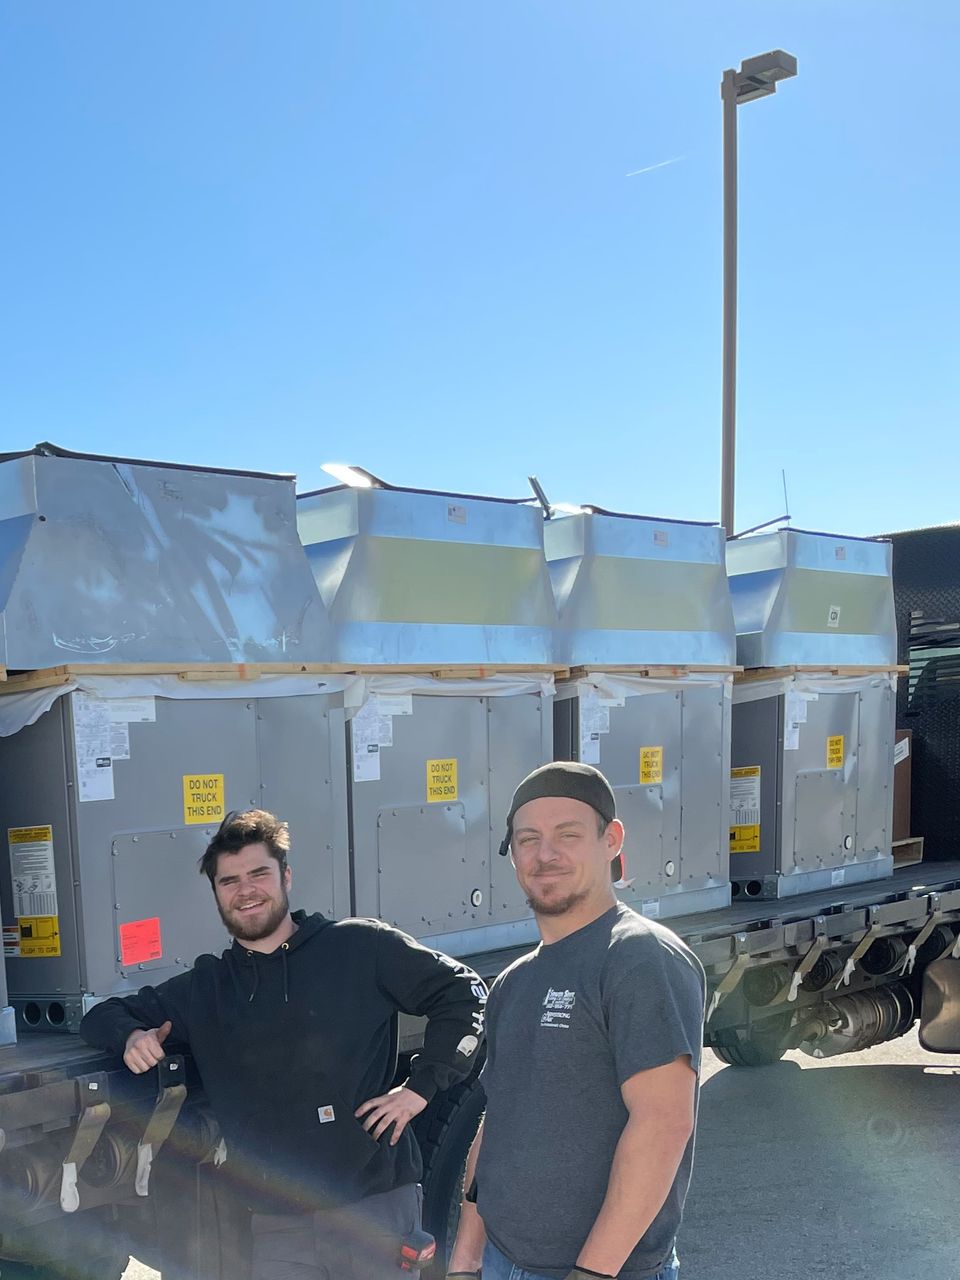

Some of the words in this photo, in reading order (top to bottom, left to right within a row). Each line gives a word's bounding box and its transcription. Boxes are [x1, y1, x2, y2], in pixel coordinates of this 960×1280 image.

[431, 763, 440, 773] DO
[441, 763, 453, 772] NOT
[189, 779, 201, 790] DO
[202, 778, 219, 789] NOT
[432, 774, 453, 784] TRUCK
[429, 786, 443, 796] THIS
[443, 785, 456, 795] END
[191, 792, 218, 803] TRUCK
[187, 806, 205, 817] THIS
[206, 805, 222, 816] END
